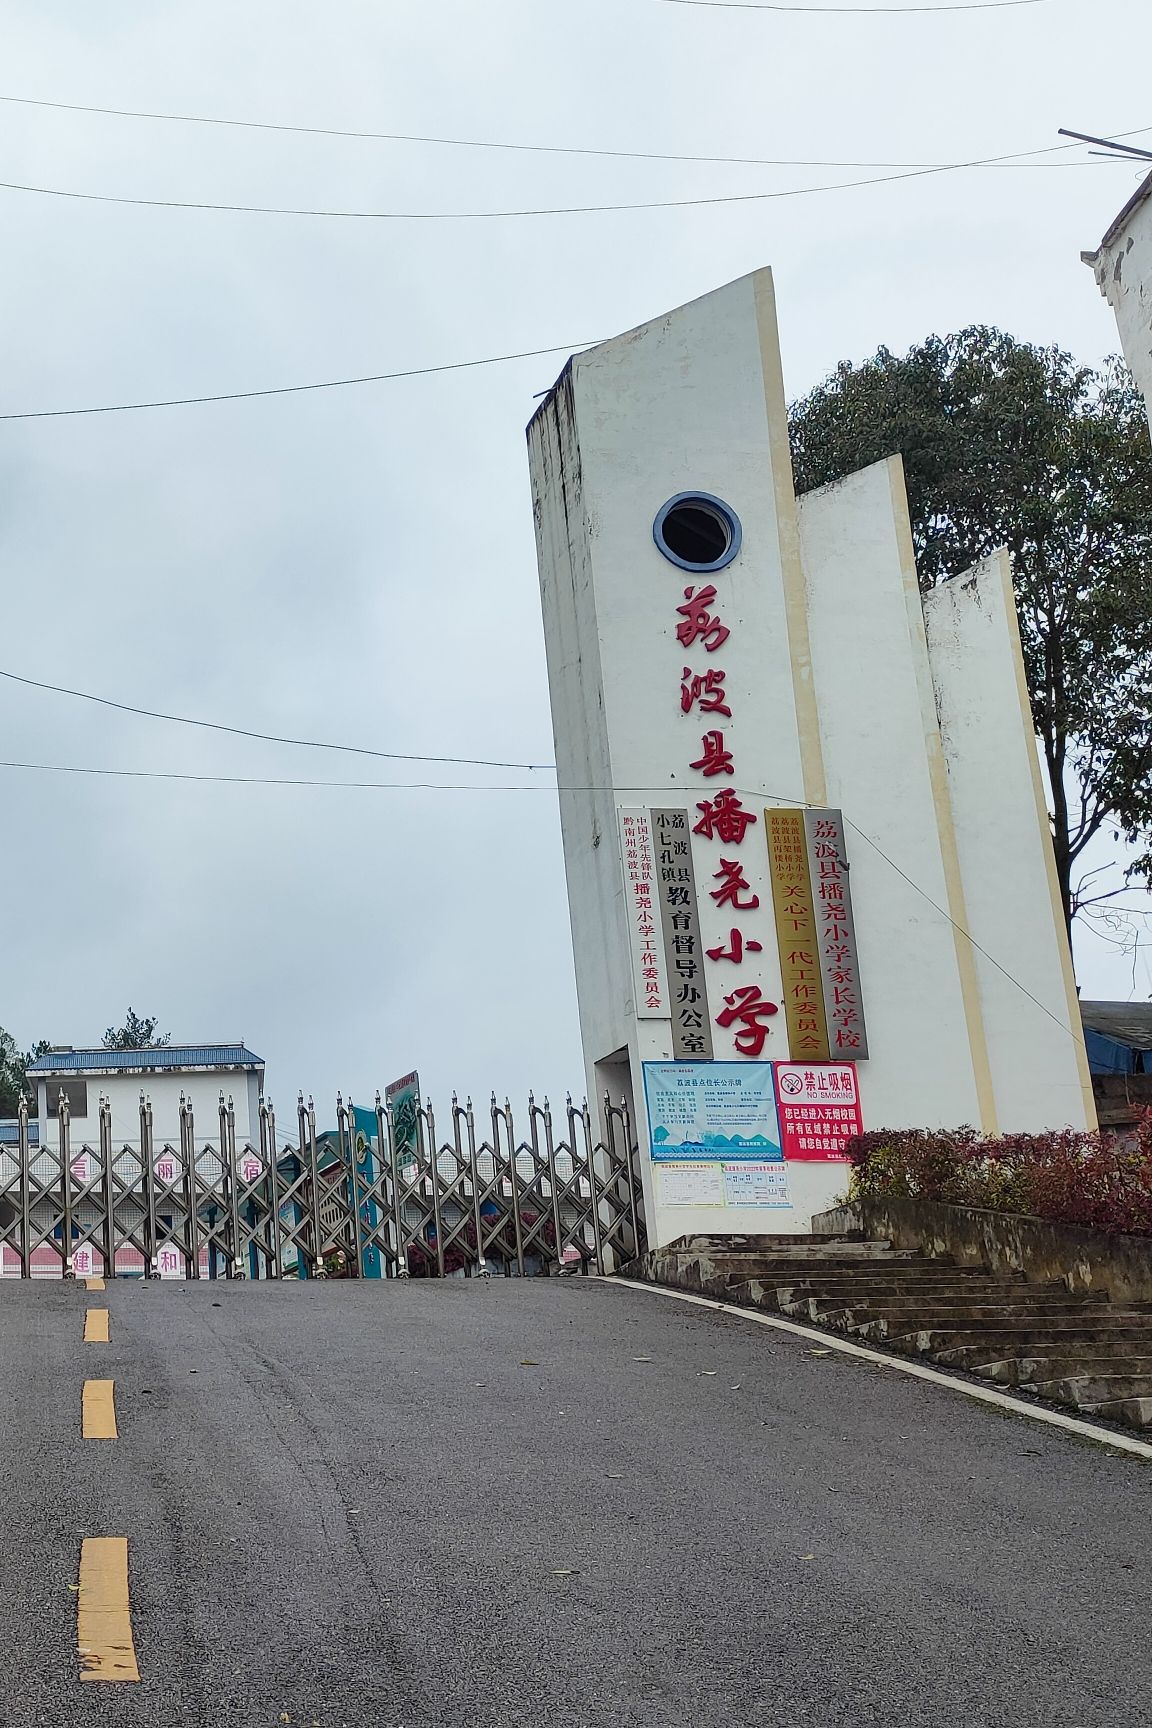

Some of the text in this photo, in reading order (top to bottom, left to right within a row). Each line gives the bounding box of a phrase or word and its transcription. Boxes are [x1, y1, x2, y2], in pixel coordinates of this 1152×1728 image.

[623, 817, 639, 880] 黔南州荔波县
[636, 817, 653, 881] 中国少年先锋队
[656, 814, 677, 883] 小七孔镇
[671, 814, 691, 883] 荔波县
[676, 585, 778, 1055] 荔波县播尧小学
[633, 883, 662, 1009] 播尧小学工作委员会
[812, 820, 861, 1048] 荔波县播尧小学家长学校
[666, 886, 706, 1053] 教育督导办公室
[781, 885, 822, 1050] 关心下一代工作委员会
[803, 1071, 852, 1091] 禁止吸烟
[820, 1092, 854, 1100] SMOKING
[784, 1108, 856, 1120] 您已经进入无烟校园
[786, 1122, 858, 1135] 所有区域禁止吸烟
[799, 1138, 846, 1150] 请您自觉遵守
[158, 1158, 173, 1178] 丽
[243, 1159, 260, 1181] 宿
[72, 1251, 90, 1272] 建
[161, 1252, 177, 1271] 和
